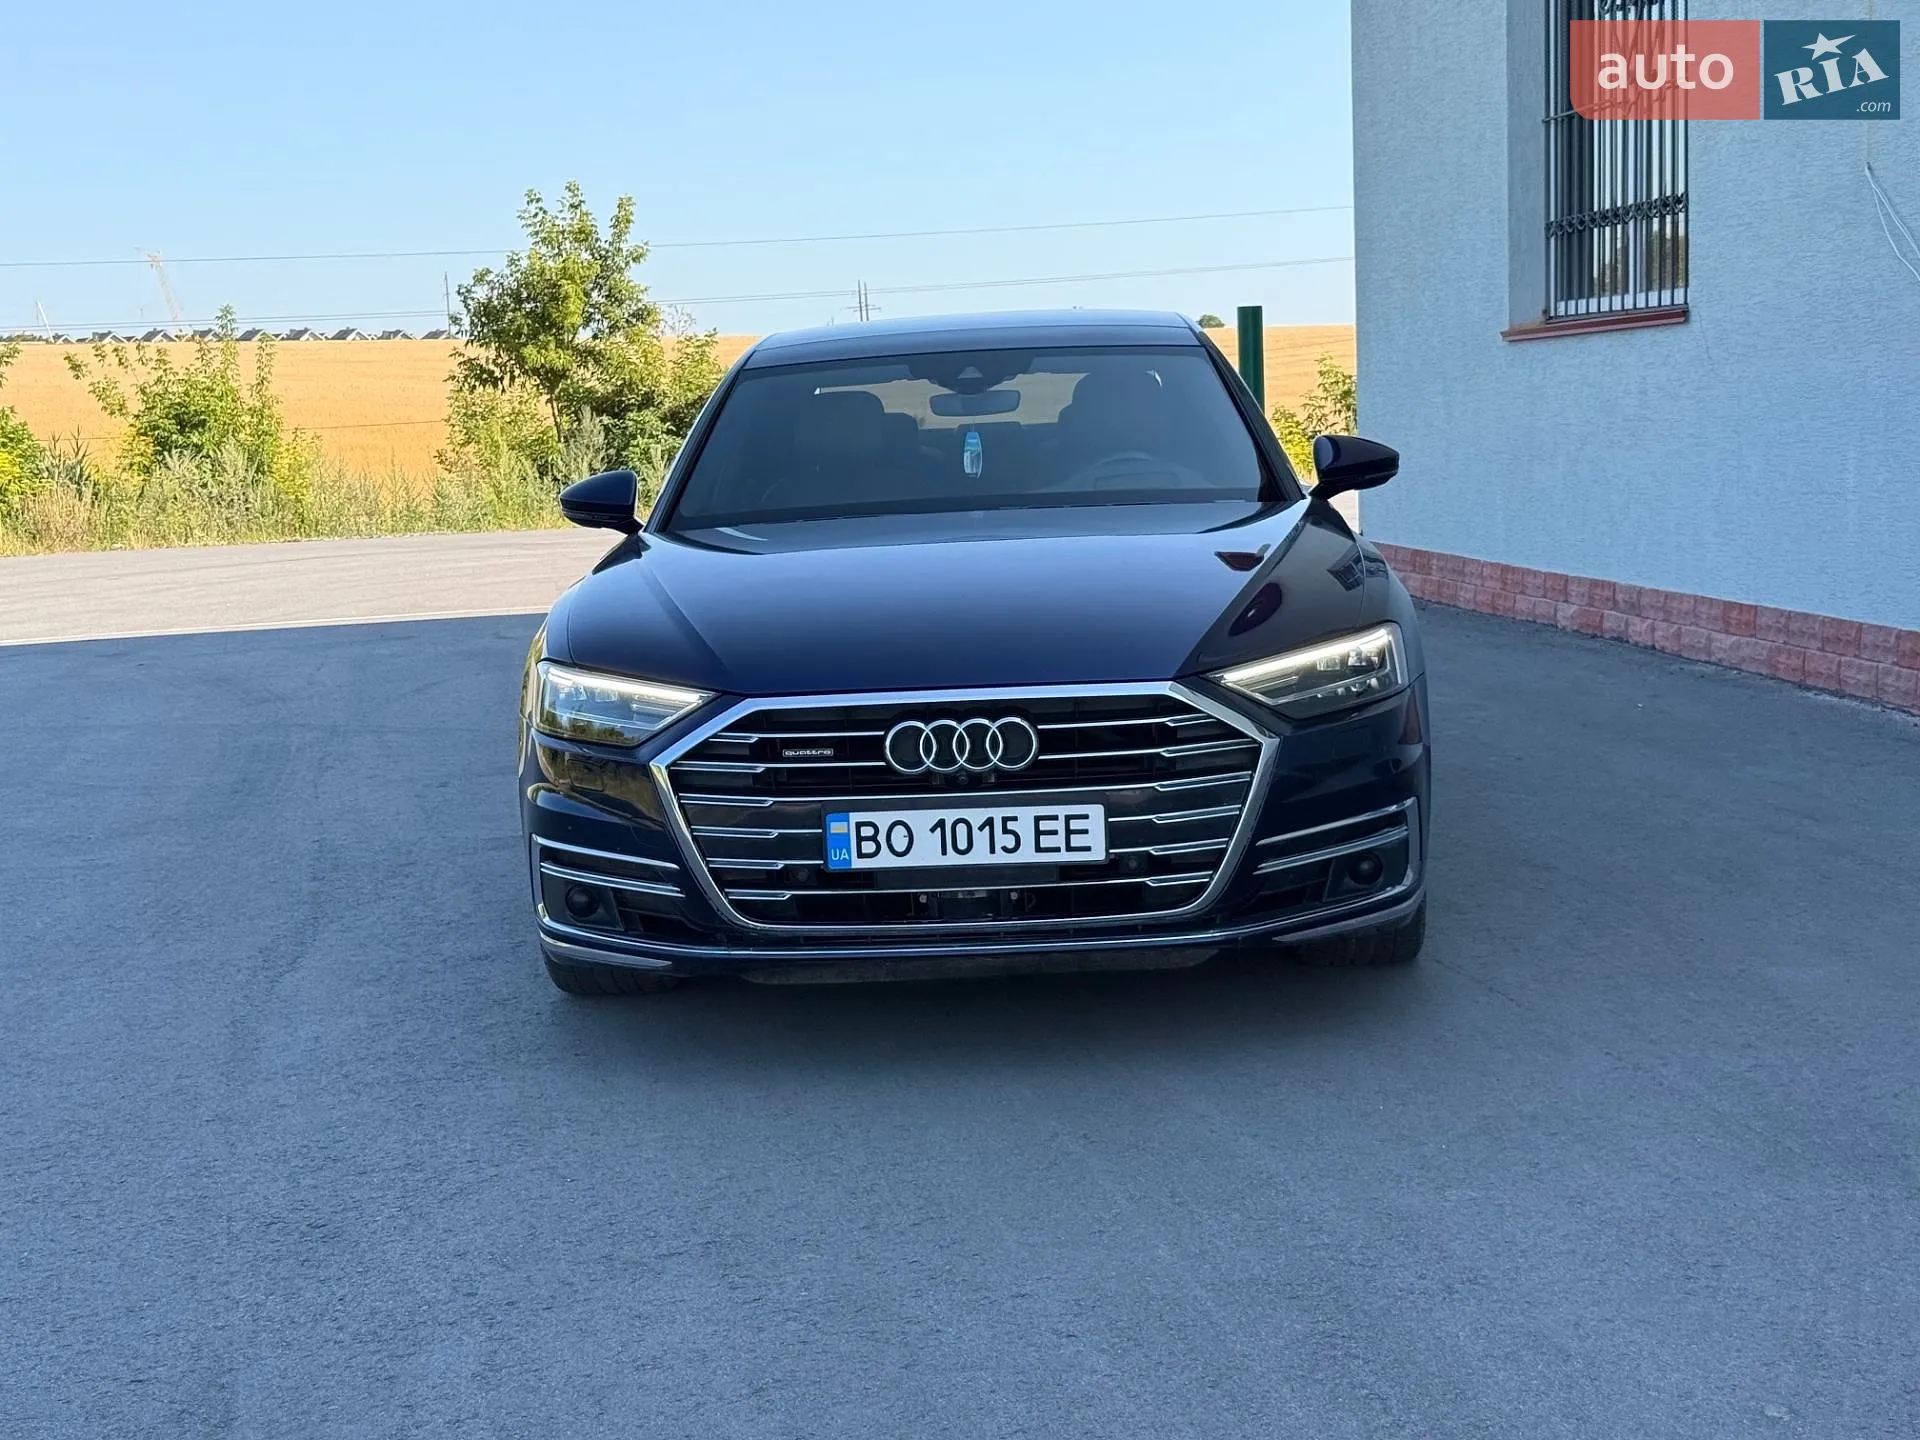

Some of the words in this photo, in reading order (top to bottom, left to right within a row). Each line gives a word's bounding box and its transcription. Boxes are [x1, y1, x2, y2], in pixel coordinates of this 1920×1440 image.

[855, 819, 914, 860] BO
[929, 816, 1022, 856] 1015
[1034, 813, 1092, 854] EE
[831, 848, 849, 861] UA
